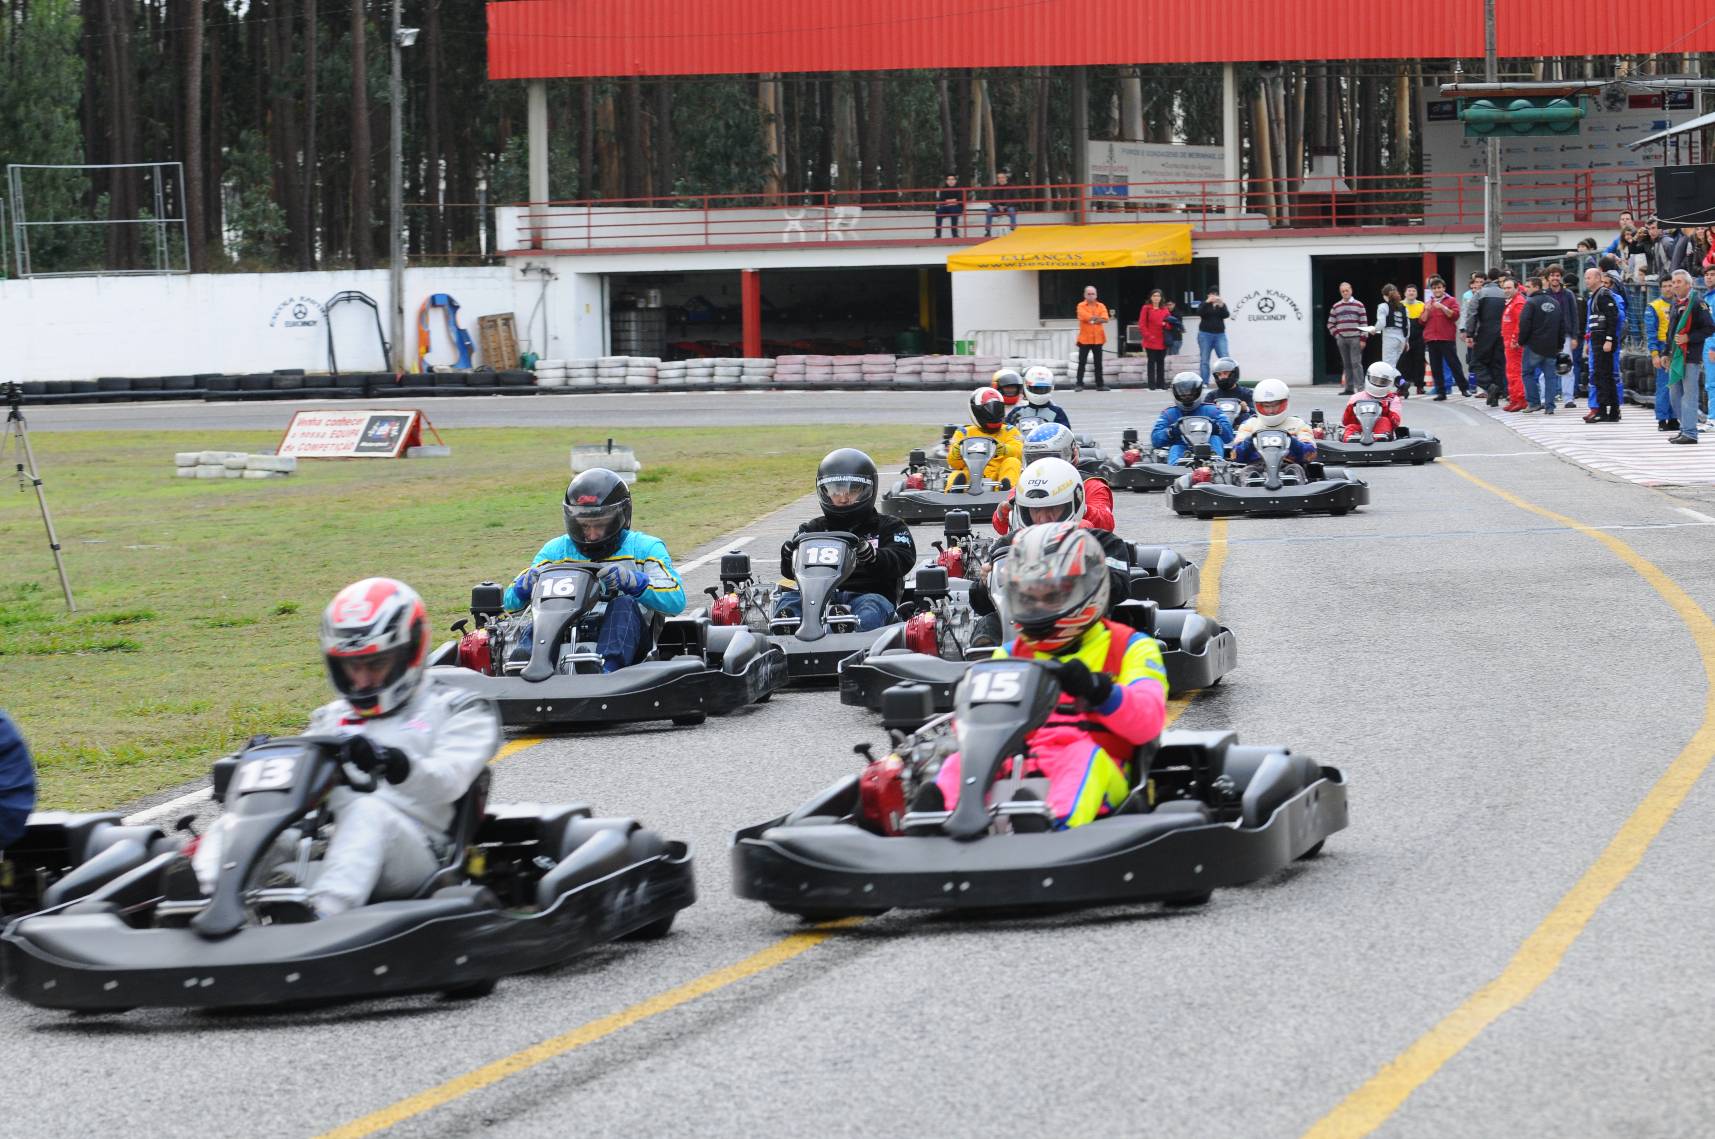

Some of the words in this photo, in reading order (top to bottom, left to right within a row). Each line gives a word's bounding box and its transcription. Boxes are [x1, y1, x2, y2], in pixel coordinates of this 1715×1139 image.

[1266, 289, 1304, 321] KARTING
[1189, 421, 1206, 431] 7
[967, 442, 987, 453] 4
[1262, 436, 1282, 446] 10
[1027, 479, 1049, 487] agv
[806, 547, 839, 564] 18
[541, 577, 575, 597] 16
[970, 671, 1021, 701] 15
[238, 756, 296, 792] 13
